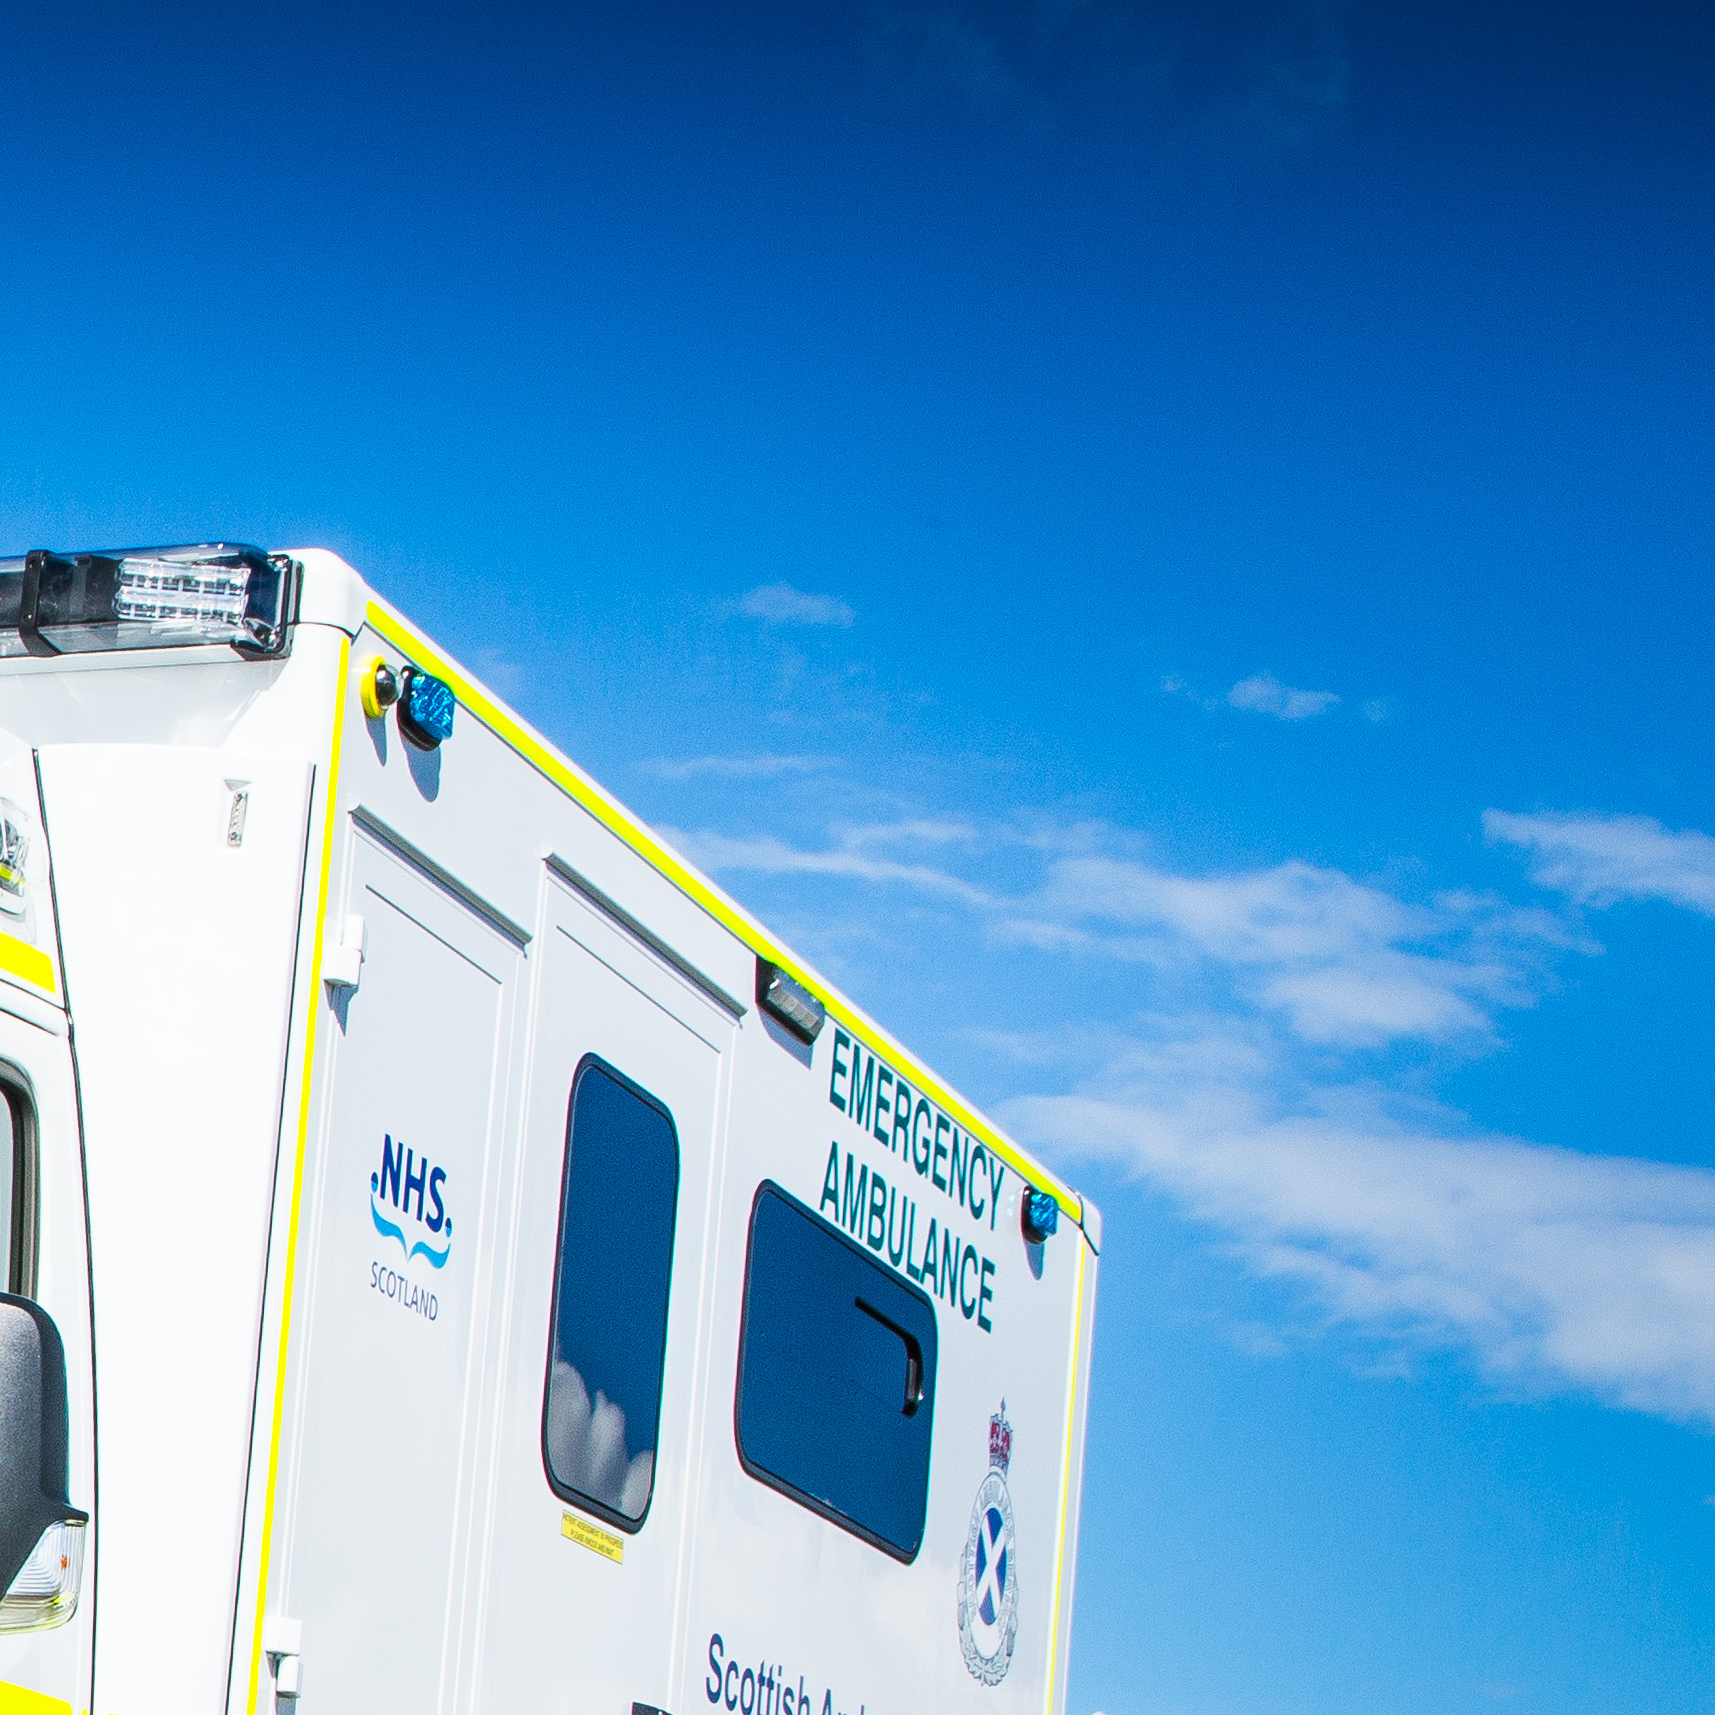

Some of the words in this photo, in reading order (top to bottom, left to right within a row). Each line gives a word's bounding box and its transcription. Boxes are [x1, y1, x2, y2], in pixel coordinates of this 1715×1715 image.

[379, 1133, 447, 1233] NHS
[829, 1028, 1005, 1231] EMERGENCY
[370, 1262, 438, 1321] SCOTLAND
[819, 1140, 996, 1334] AMBULANCE
